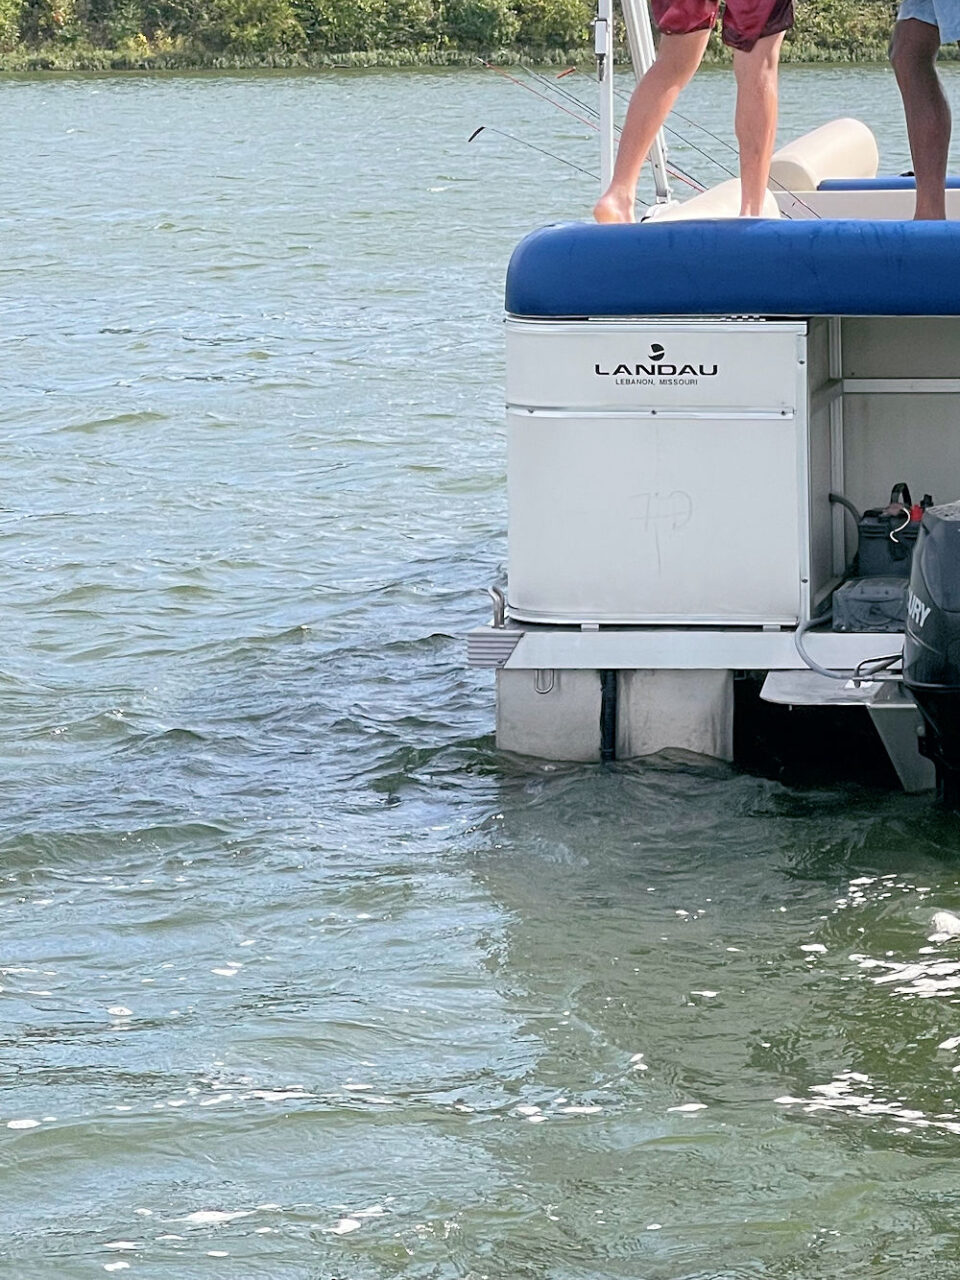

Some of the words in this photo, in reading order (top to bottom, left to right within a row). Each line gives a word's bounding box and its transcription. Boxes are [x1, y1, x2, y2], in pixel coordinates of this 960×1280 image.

[595, 364, 718, 376] LANDAU
[615, 378, 655, 386] LEBANON,
[659, 378, 698, 386] MISSOURI
